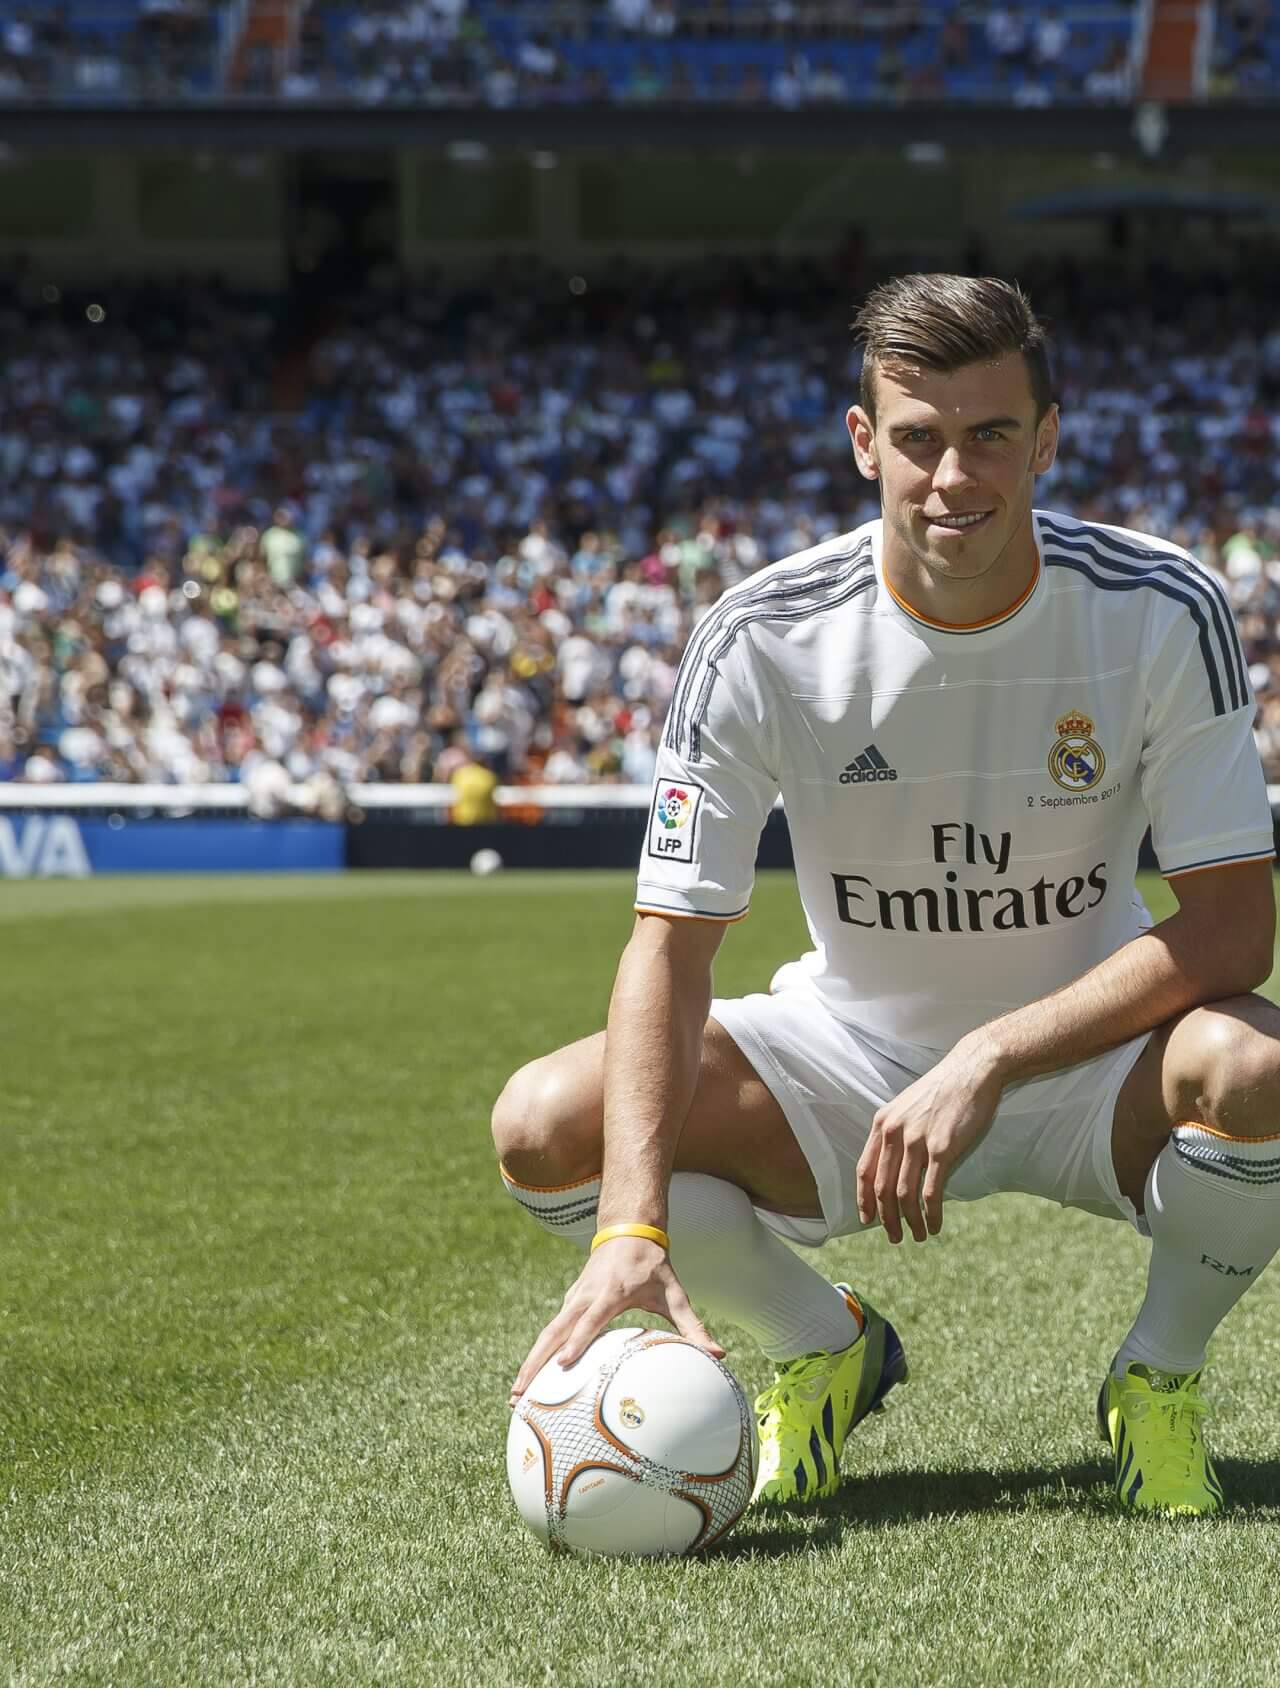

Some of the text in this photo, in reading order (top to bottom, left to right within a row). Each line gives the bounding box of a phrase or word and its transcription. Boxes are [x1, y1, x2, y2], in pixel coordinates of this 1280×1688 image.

[839, 769, 898, 784] adidas
[1027, 796, 1034, 807] 2
[1040, 794, 1098, 809] Septiembre
[657, 836, 682, 853] LFP
[931, 822, 1011, 874] Fly
[830, 862, 1107, 932] Emirates
